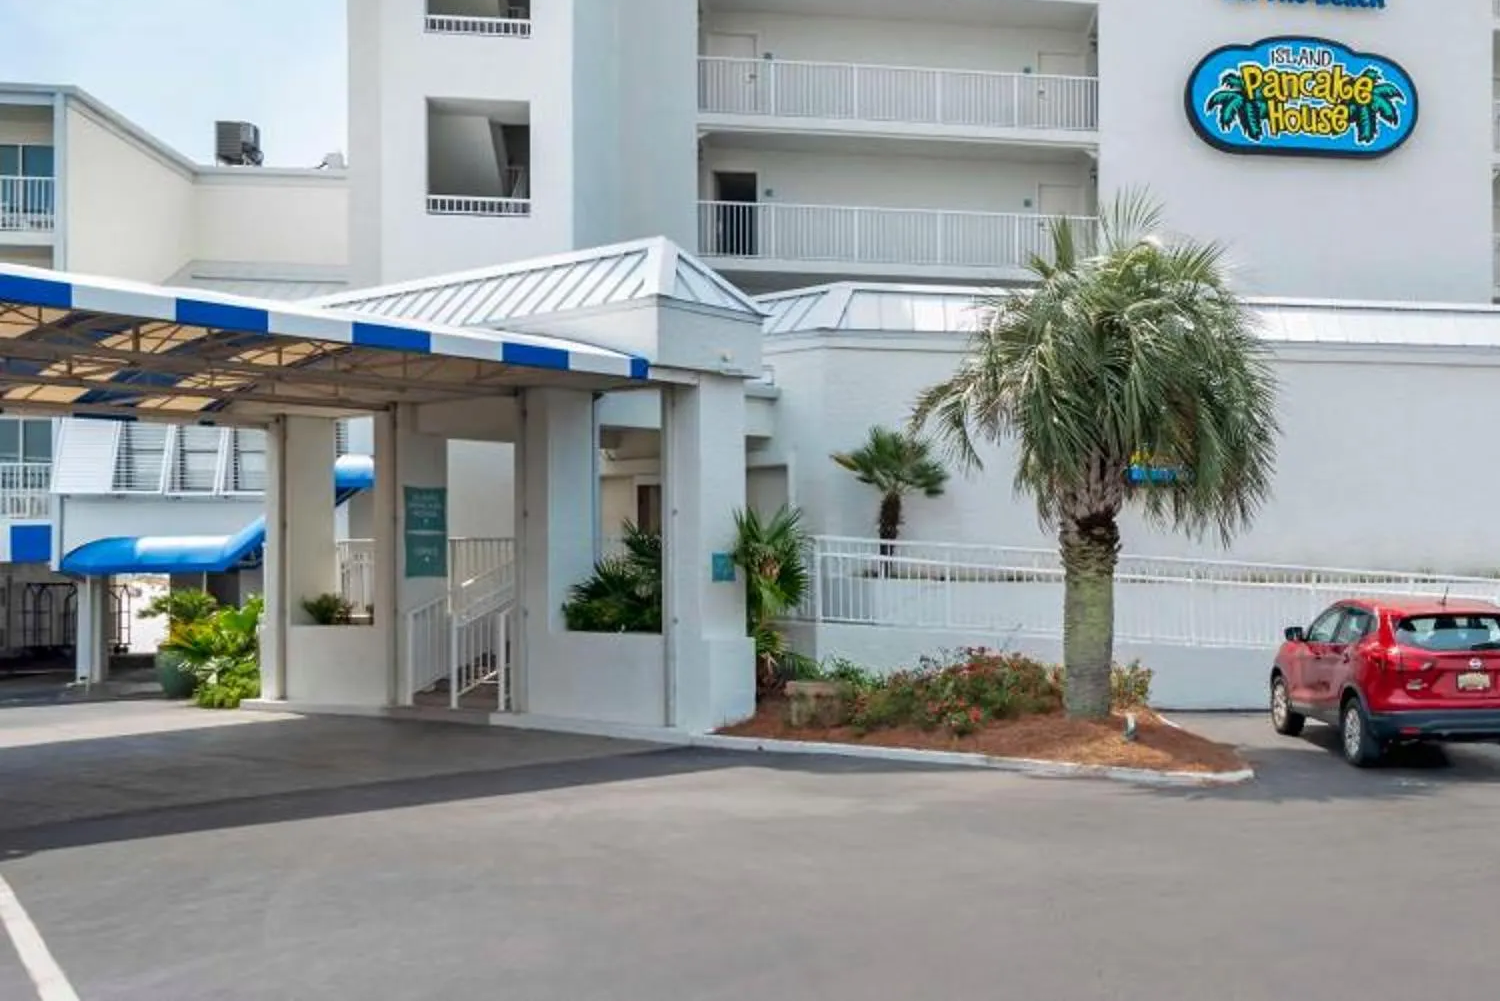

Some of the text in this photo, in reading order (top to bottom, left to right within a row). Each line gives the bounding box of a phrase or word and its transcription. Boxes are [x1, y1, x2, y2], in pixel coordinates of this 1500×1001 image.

[1271, 49, 1333, 66] ISLAND
[1240, 65, 1374, 106] Pancake
[1267, 100, 1349, 136] House
